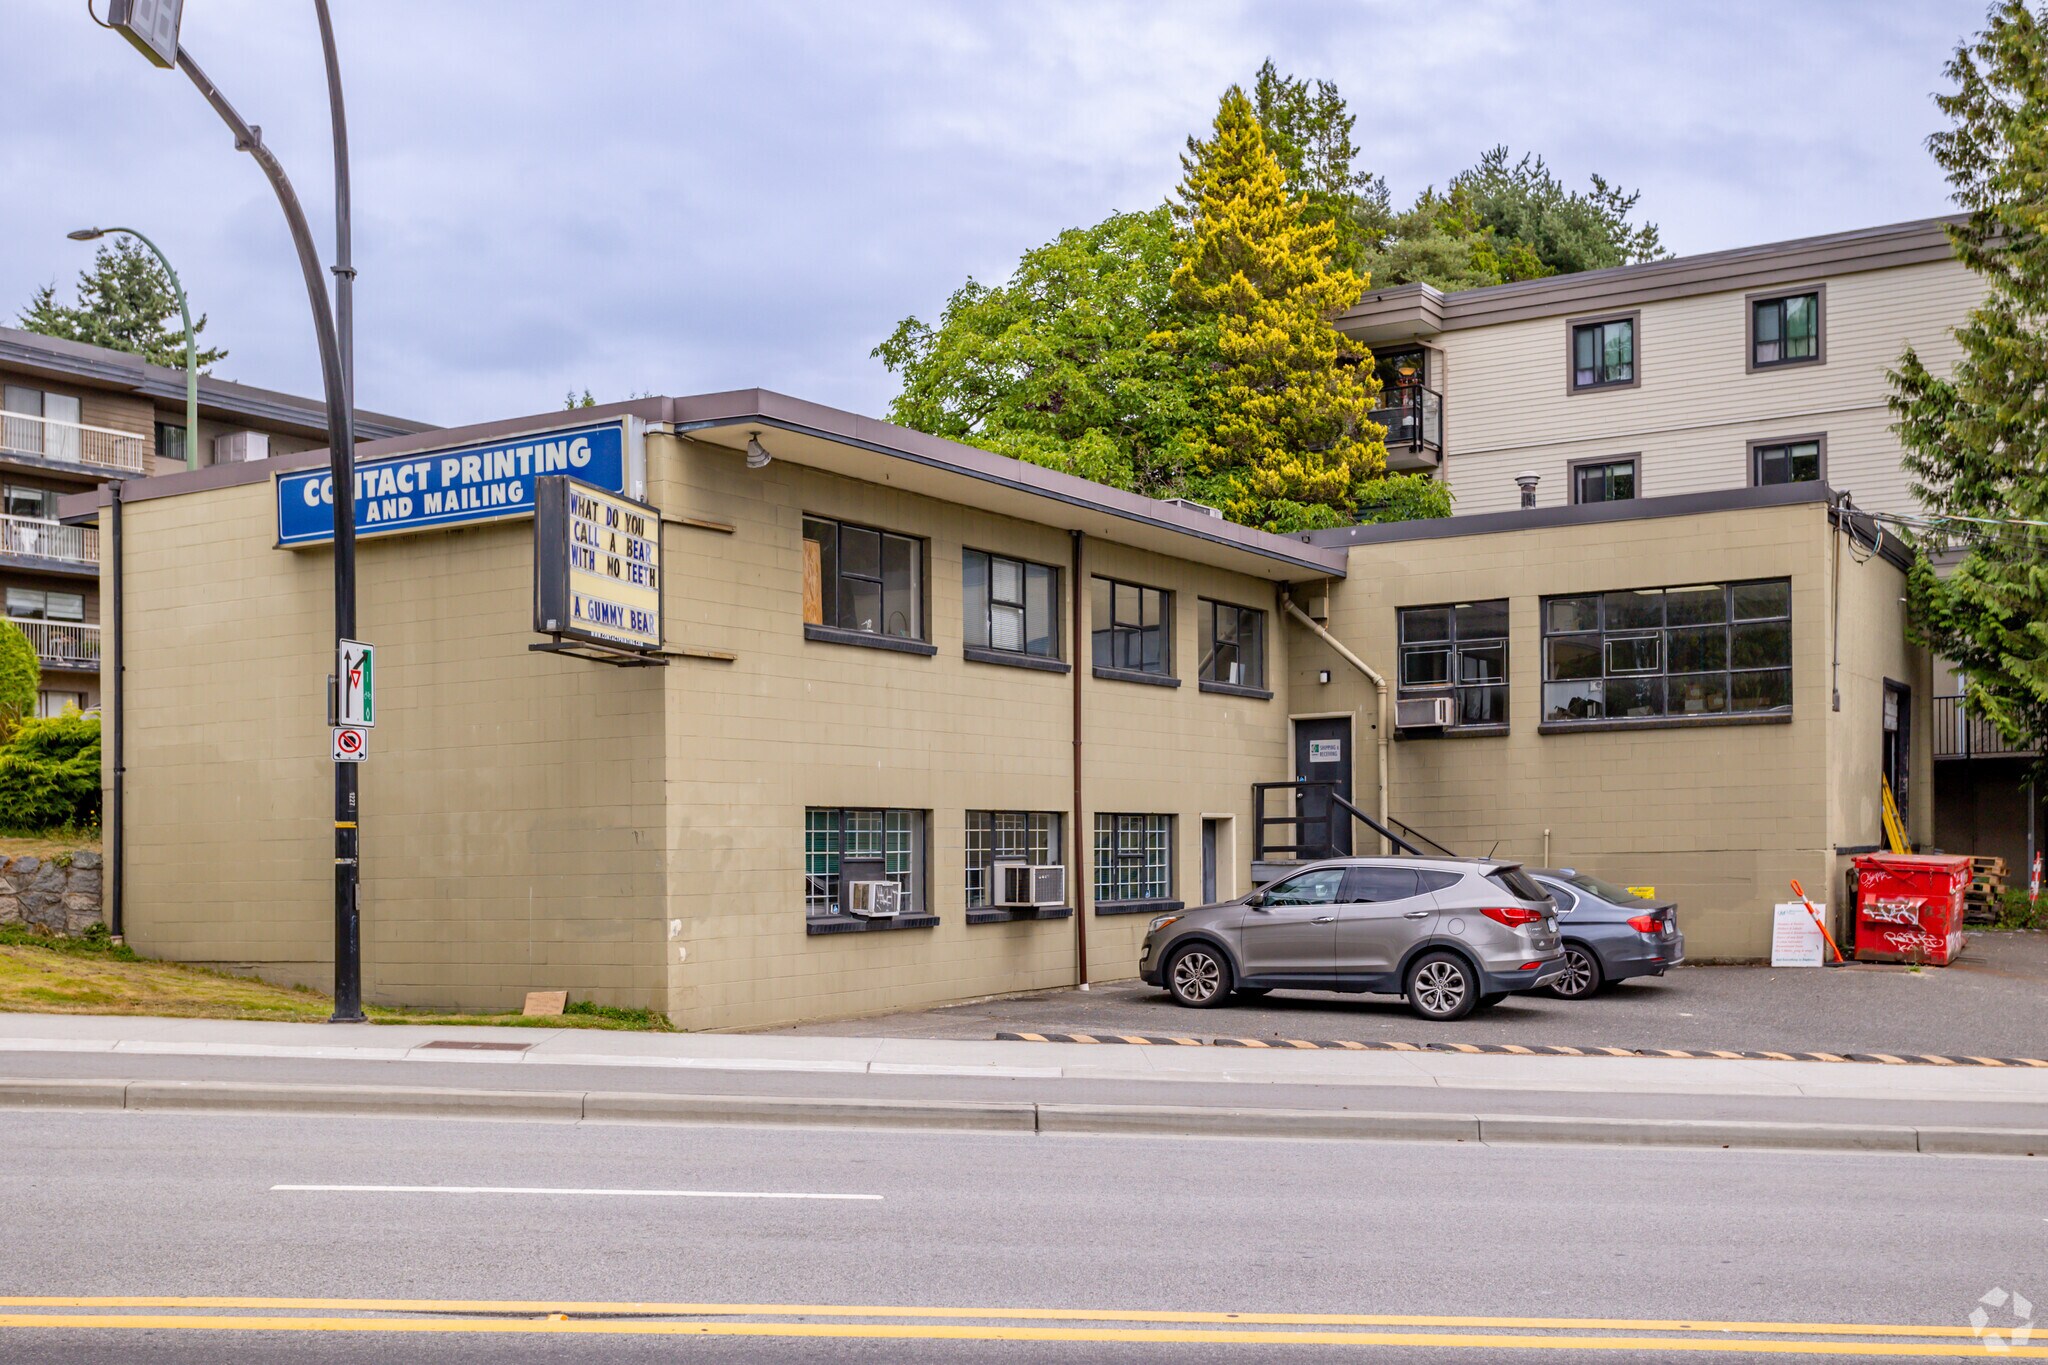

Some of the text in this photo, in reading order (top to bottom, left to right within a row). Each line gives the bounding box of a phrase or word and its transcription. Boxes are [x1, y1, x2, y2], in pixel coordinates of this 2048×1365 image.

[441, 437, 592, 487] PRINTING
[366, 480, 524, 522] AND MAILING
[570, 493, 644, 537] WHAT DO YOU
[574, 520, 652, 563] CALL A BEAR
[571, 544, 656, 587] WITH NO TEETH
[574, 596, 655, 633] A GUMMY BEAR
